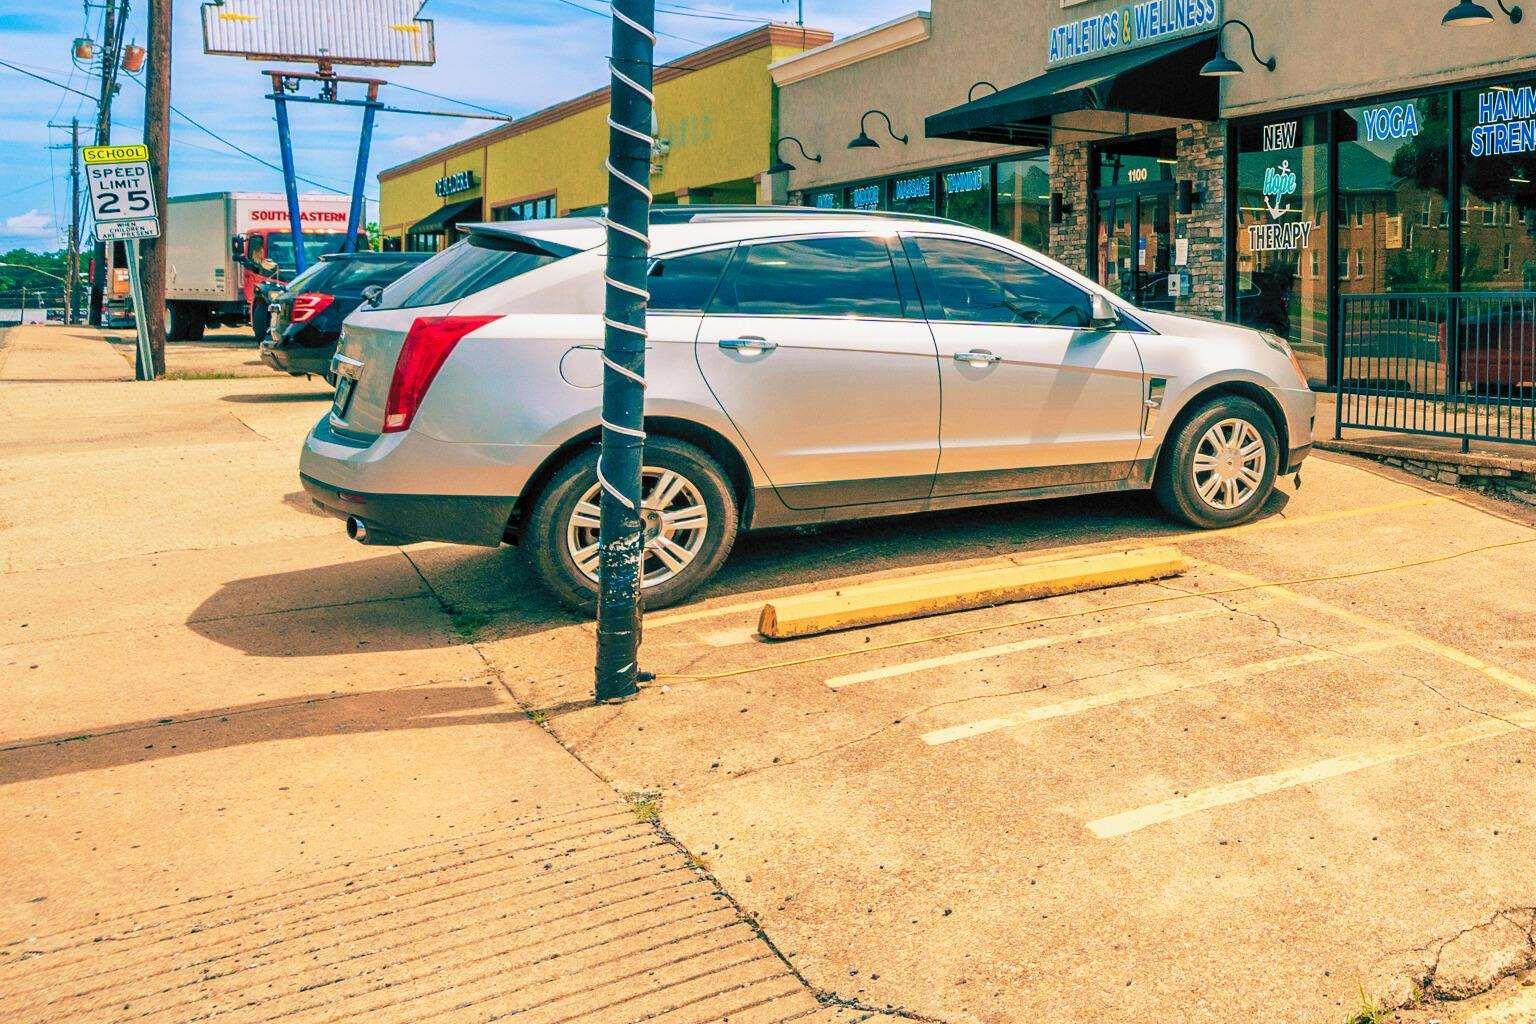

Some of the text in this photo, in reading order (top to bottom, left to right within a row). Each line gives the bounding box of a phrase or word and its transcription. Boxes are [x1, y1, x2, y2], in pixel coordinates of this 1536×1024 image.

[1048, 11, 1118, 63] ATHLETICS
[1122, 7, 1132, 46] &
[1363, 104, 1419, 142] YOGA
[1263, 121, 1297, 152] NEW
[88, 148, 143, 160] SCHOOL
[92, 166, 145, 179] SPEED
[1127, 168, 1148, 182] 1100
[100, 179, 140, 190] LIMIT
[1263, 167, 1297, 204] Hope
[96, 190, 150, 214] 25
[251, 210, 347, 222] SOUTHASTERN
[110, 225, 146, 234] CHILDREN
[1248, 221, 1311, 252] THERAPY
